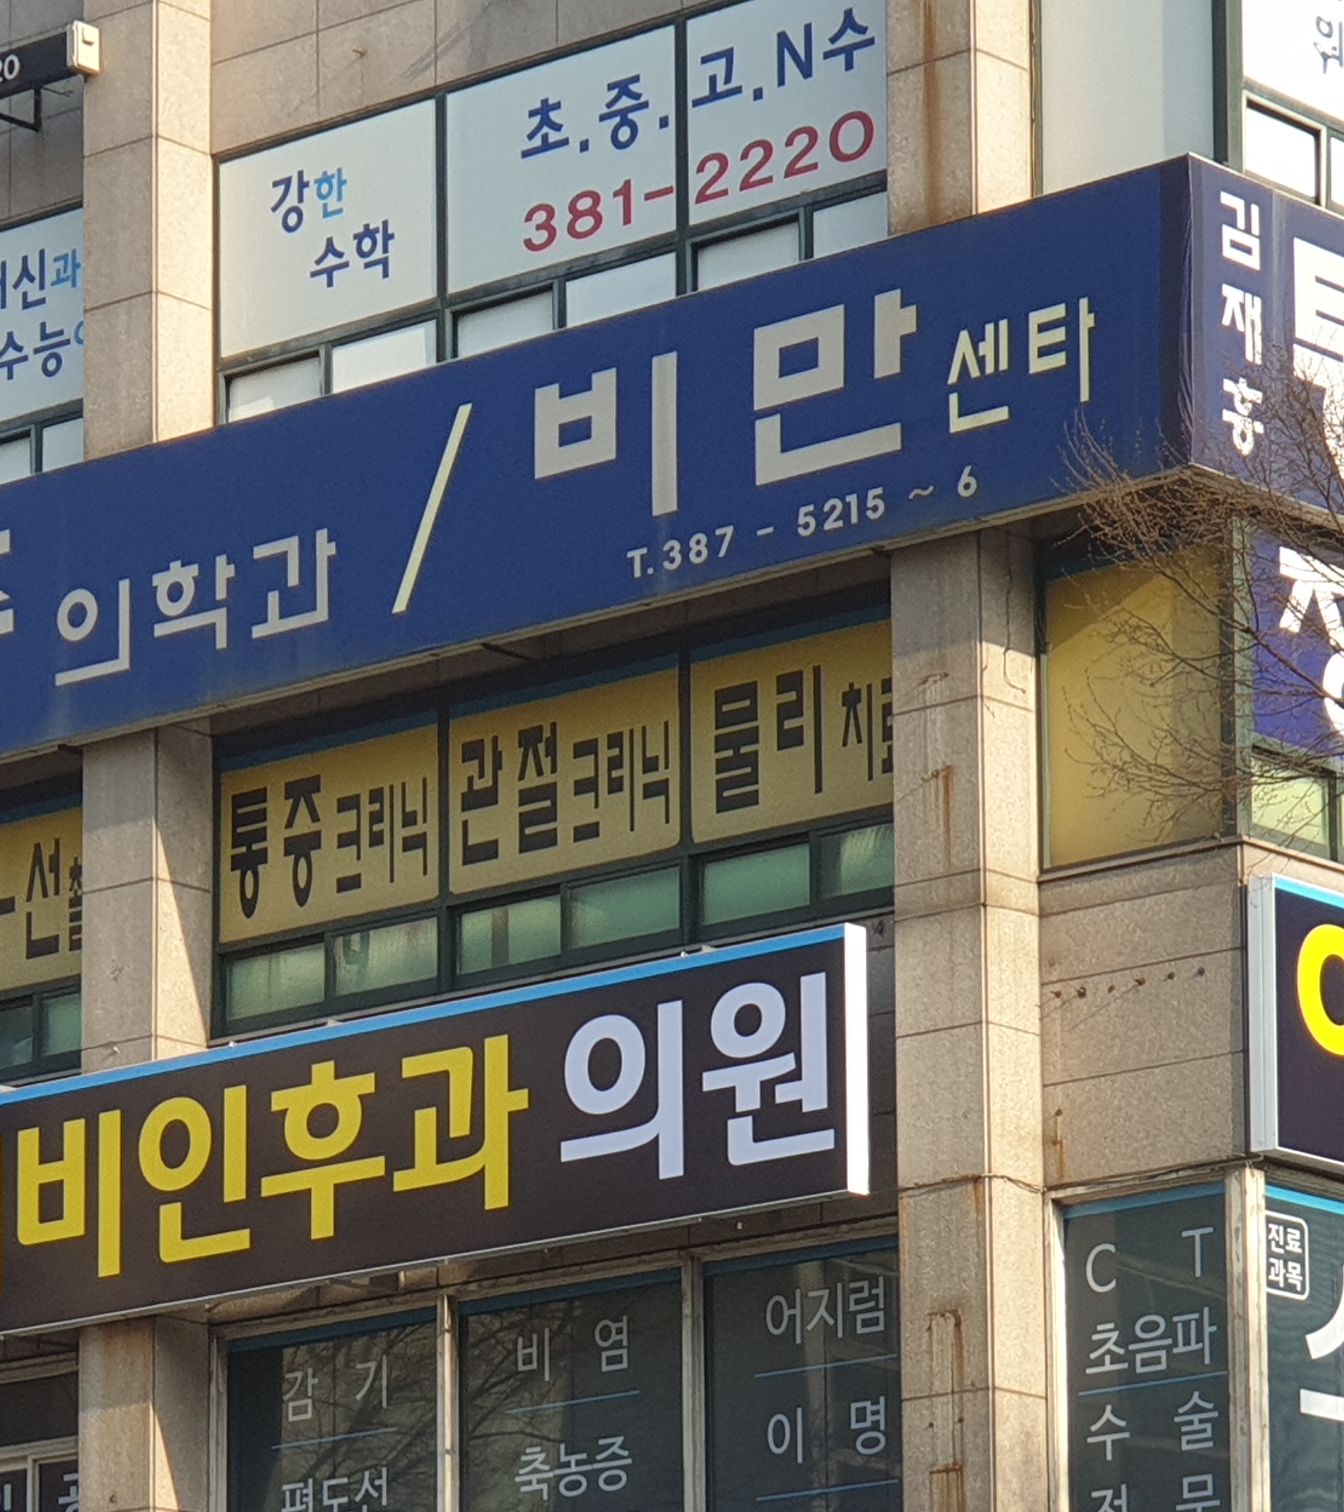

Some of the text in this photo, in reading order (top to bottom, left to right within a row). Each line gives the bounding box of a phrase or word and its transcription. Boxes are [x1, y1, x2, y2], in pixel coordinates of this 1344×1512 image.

[269, 167, 347, 235] 강한
[523, 110, 875, 254] 381-2220
[310, 219, 396, 289] 수학
[534, 287, 1096, 517] 비만 센타
[55, 527, 337, 686] 의학과
[561, 972, 836, 1180] 의원
[1267, 1223, 1303, 1255] 진료
[1267, 1257, 1304, 1292] 과목
[765, 1276, 887, 1346] 어지럼
[1084, 1306, 1218, 1376] 초음파
[514, 1436, 633, 1502] 축농증
